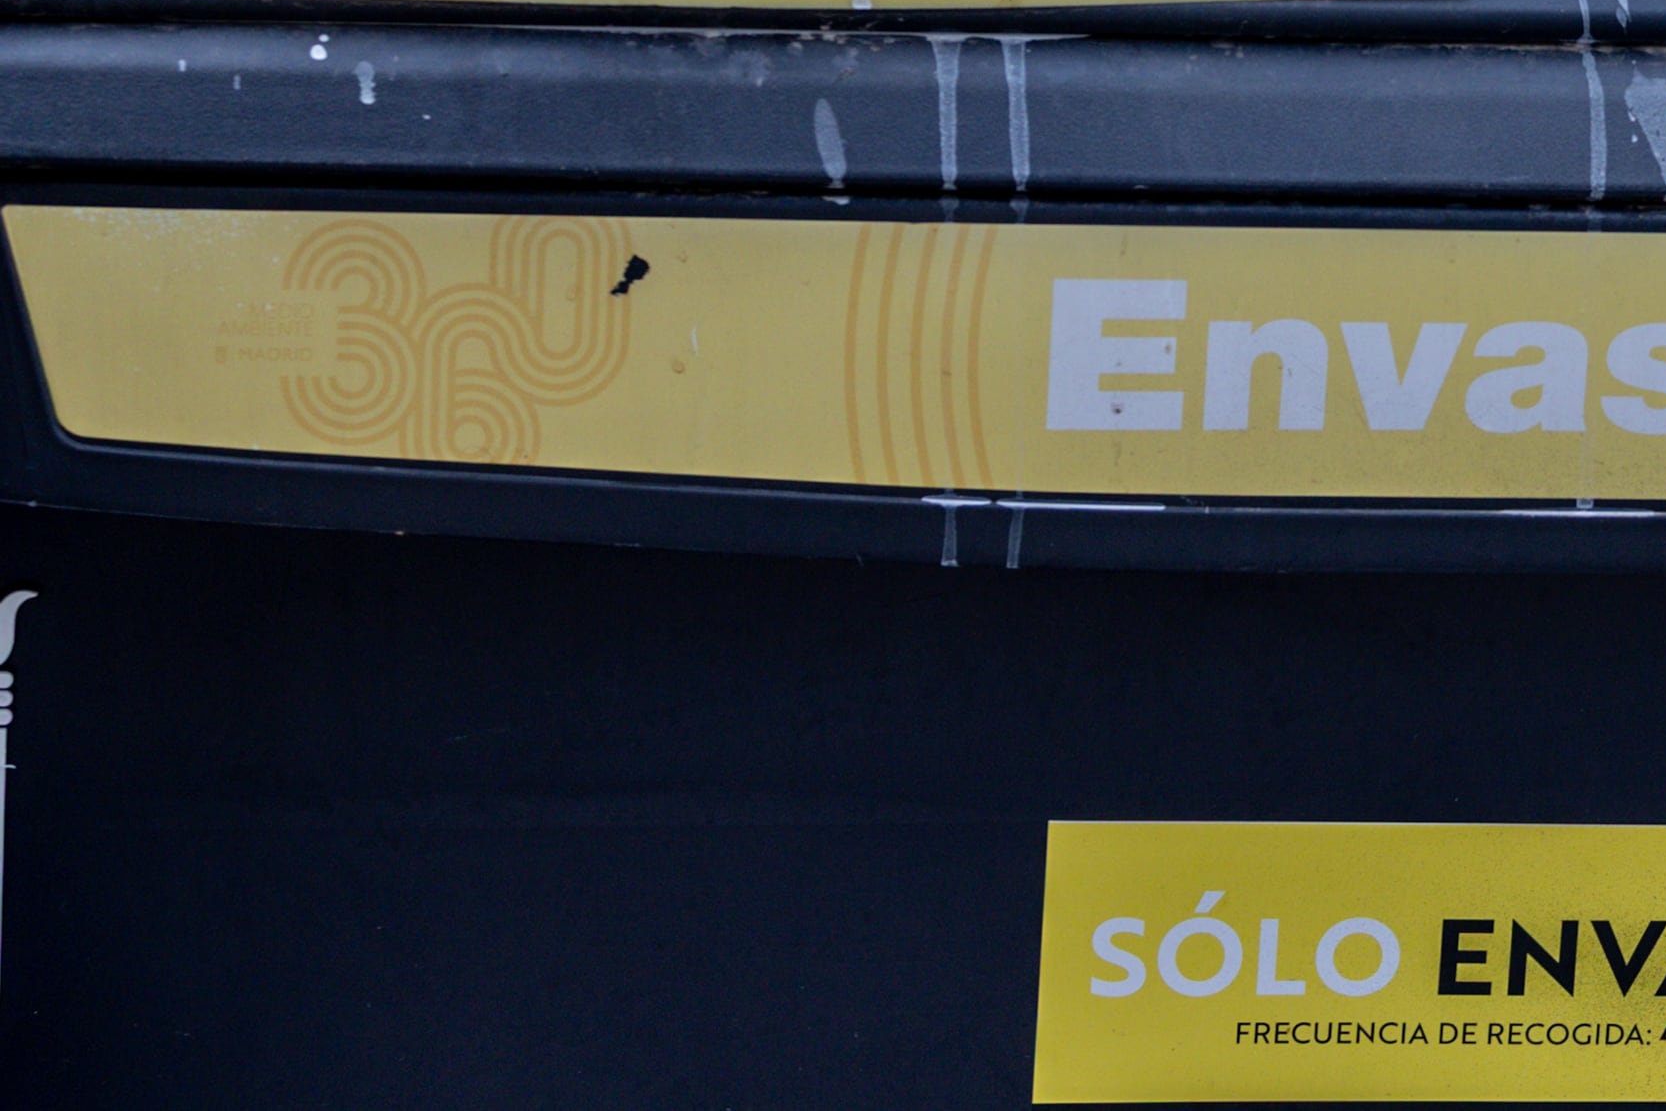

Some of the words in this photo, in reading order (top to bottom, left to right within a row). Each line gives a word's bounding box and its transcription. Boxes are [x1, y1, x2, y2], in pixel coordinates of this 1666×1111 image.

[217, 320, 314, 337] AMBIENTE
[238, 346, 314, 362] MADRID
[1090, 890, 1401, 998] SÓLO
[1236, 1021, 1430, 1045] FRECUENCIA
[1438, 1022, 1478, 1045] DE
[1487, 1022, 1653, 1046] RECOGIDA:
